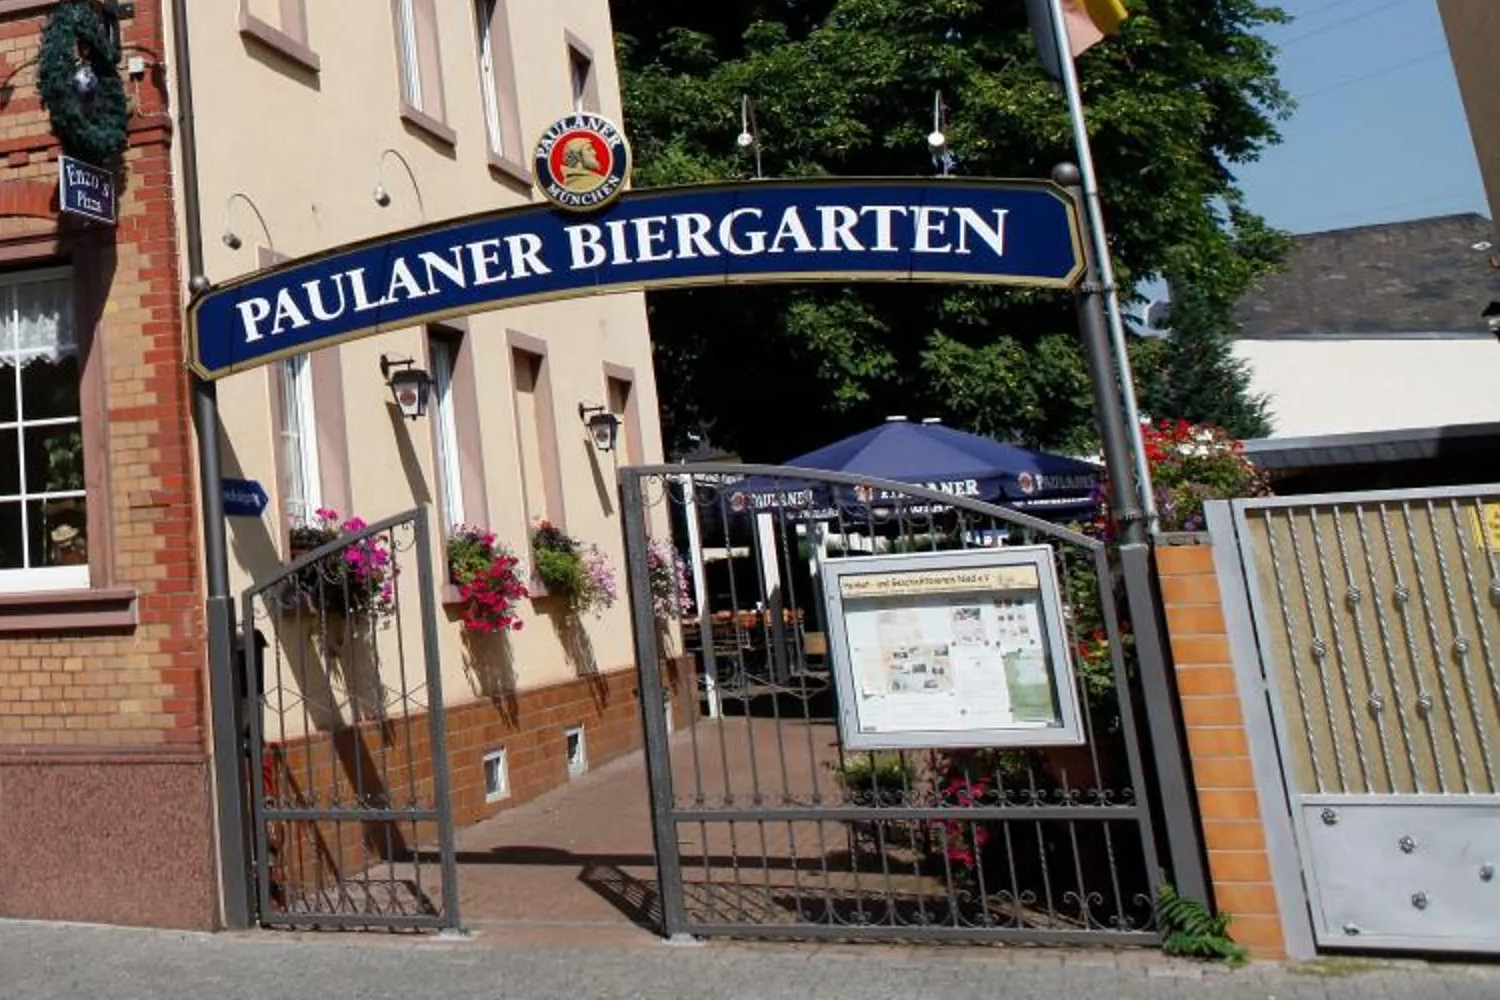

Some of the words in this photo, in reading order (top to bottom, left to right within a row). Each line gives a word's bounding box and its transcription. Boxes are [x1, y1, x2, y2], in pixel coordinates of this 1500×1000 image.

[536, 112, 622, 158] PAULANER
[236, 232, 552, 343] PAULANER
[564, 204, 1009, 270] BIERGARTEN
